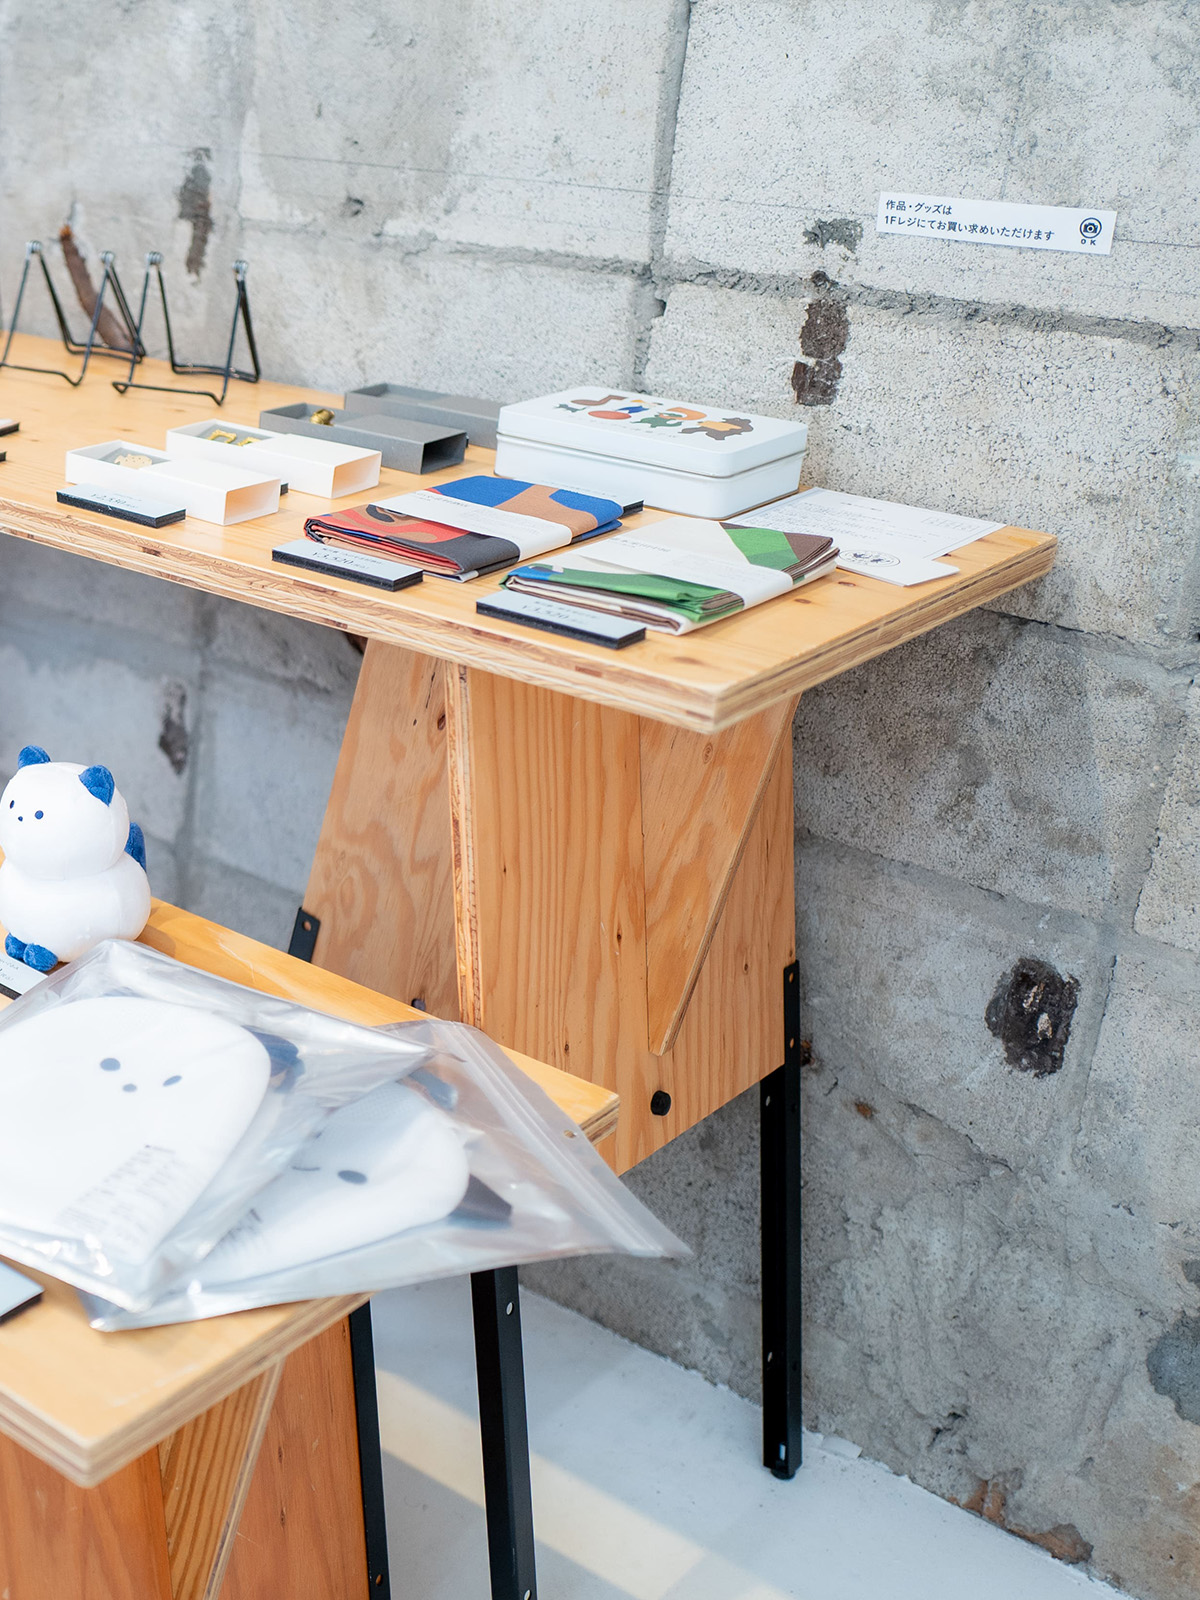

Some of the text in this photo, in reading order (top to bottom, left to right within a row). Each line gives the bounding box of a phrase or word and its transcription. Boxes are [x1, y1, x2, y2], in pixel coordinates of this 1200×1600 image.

[885, 199, 953, 216] 作品・グッズは
[884, 215, 1055, 241] 1Fレジにてお買い求めいただけます
